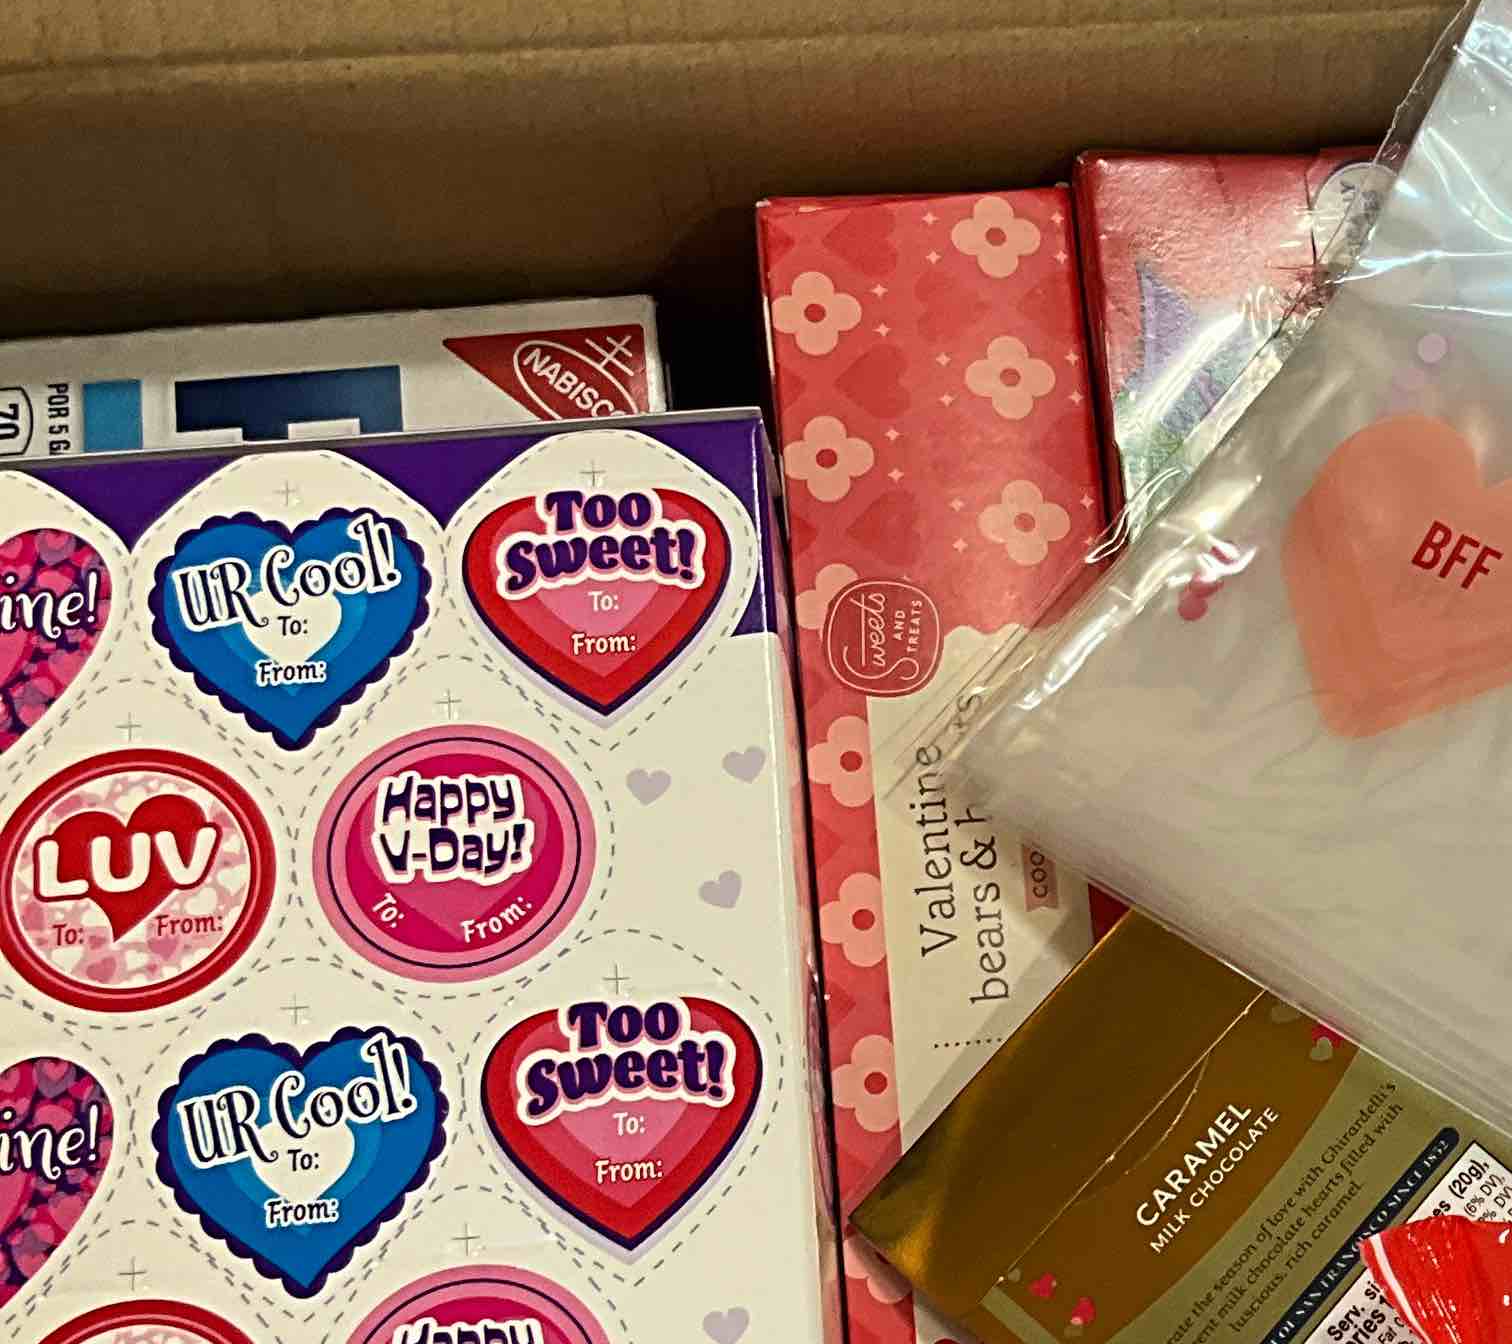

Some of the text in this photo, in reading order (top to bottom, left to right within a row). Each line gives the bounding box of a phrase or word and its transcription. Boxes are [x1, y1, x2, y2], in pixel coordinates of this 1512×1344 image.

[523, 348, 626, 416] NABISC
[48, 384, 69, 434] POR 5
[545, 490, 650, 532] Too
[179, 516, 401, 632] UR Cool!
[505, 529, 696, 590] Sweet!
[1412, 520, 1503, 591] BFF
[0, 576, 97, 639] ine!
[278, 616, 309, 637] To:
[589, 591, 619, 611] To:
[893, 609, 904, 640] AND
[910, 598, 923, 653] TREATS
[571, 632, 636, 653] From:
[843, 592, 909, 680] Sweets
[257, 660, 327, 682] From:
[382, 776, 517, 824] Happy
[37, 827, 218, 899] LUV
[380, 824, 526, 875] V-Day!
[910, 743, 957, 957] Valentine
[960, 835, 997, 870] &
[53, 911, 223, 945] To: From:
[373, 892, 534, 944] To: From:
[970, 882, 1008, 1005] bears
[568, 1002, 681, 1047] Too
[184, 1039, 413, 1161] UR Cool!
[526, 1046, 726, 1114] Sweet!
[0, 1105, 98, 1177] ine!
[613, 1112, 645, 1135] To:
[287, 1149, 320, 1172] To:
[595, 1158, 663, 1182] From:
[1130, 1096, 1254, 1230] CARAMEL
[1146, 1105, 1282, 1254] MILK CHOCOLATE
[267, 1199, 339, 1225] From:
[1188, 1289, 1216, 1318] the
[1210, 1241, 1259, 1293] season
[1251, 1221, 1277, 1247] of
[1265, 1195, 1298, 1229] love
[1290, 1163, 1325, 1199] with
[1317, 1078, 1399, 1166] Ghirardelli's
[1212, 1282, 1248, 1320] milk
[1242, 1214, 1309, 1286] chocolate
[1300, 1169, 1347, 1218] hearts
[1338, 1132, 1379, 1175] filled
[1370, 1100, 1405, 1137] with
[1281, 1237, 1313, 1270] rich
[1326, 1299, 1367, 1343] Serv.
